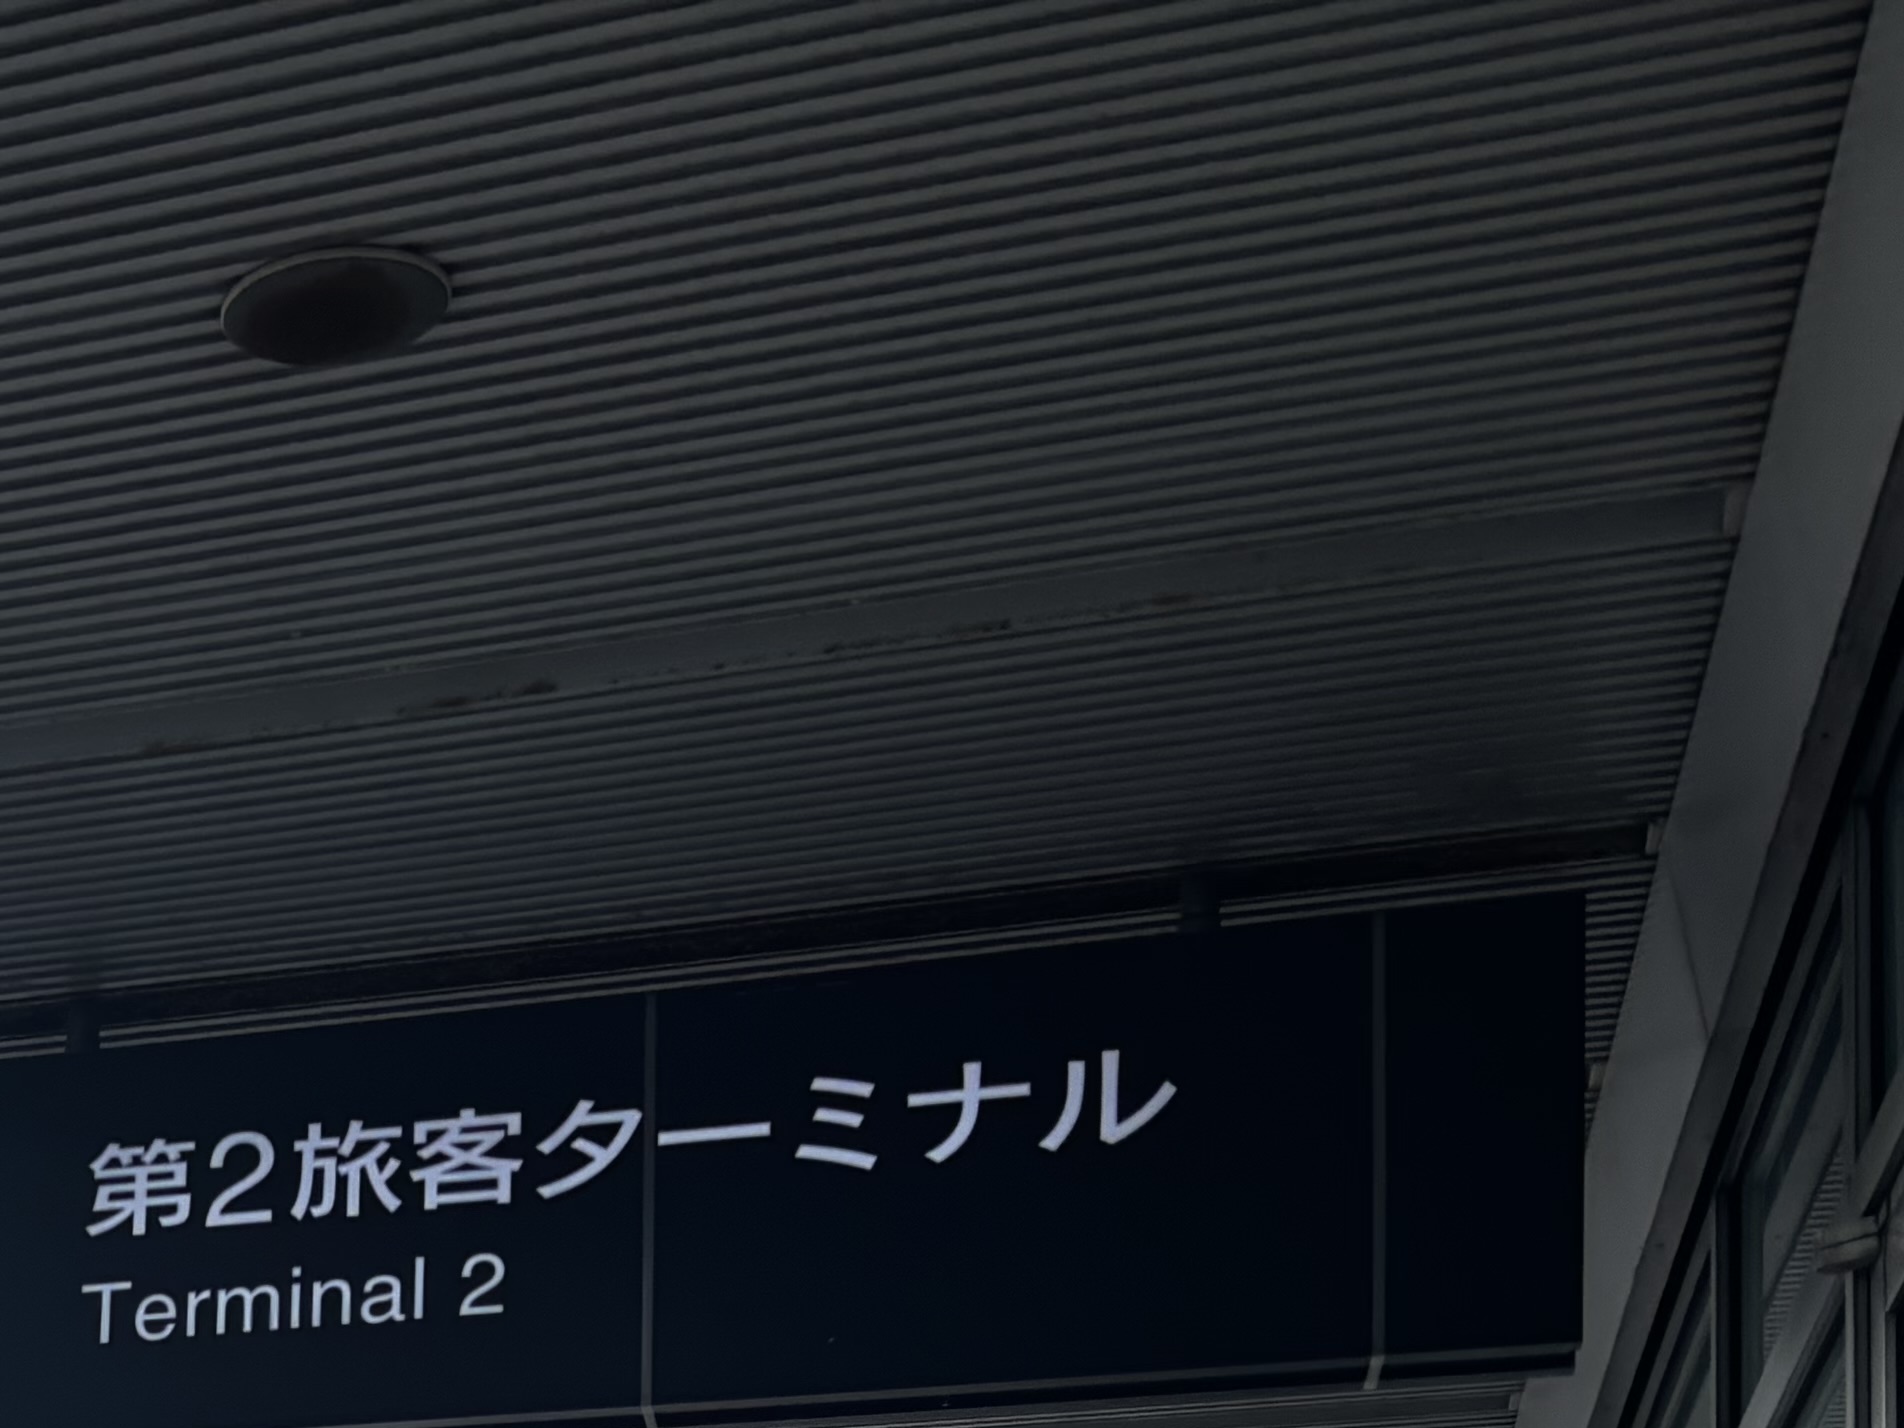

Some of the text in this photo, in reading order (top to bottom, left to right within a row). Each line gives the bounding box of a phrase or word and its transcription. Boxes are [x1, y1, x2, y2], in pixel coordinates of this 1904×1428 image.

[84, 1048, 1178, 1237] 第2旅客ターミナル
[81, 1252, 506, 1344] Terminal 2
